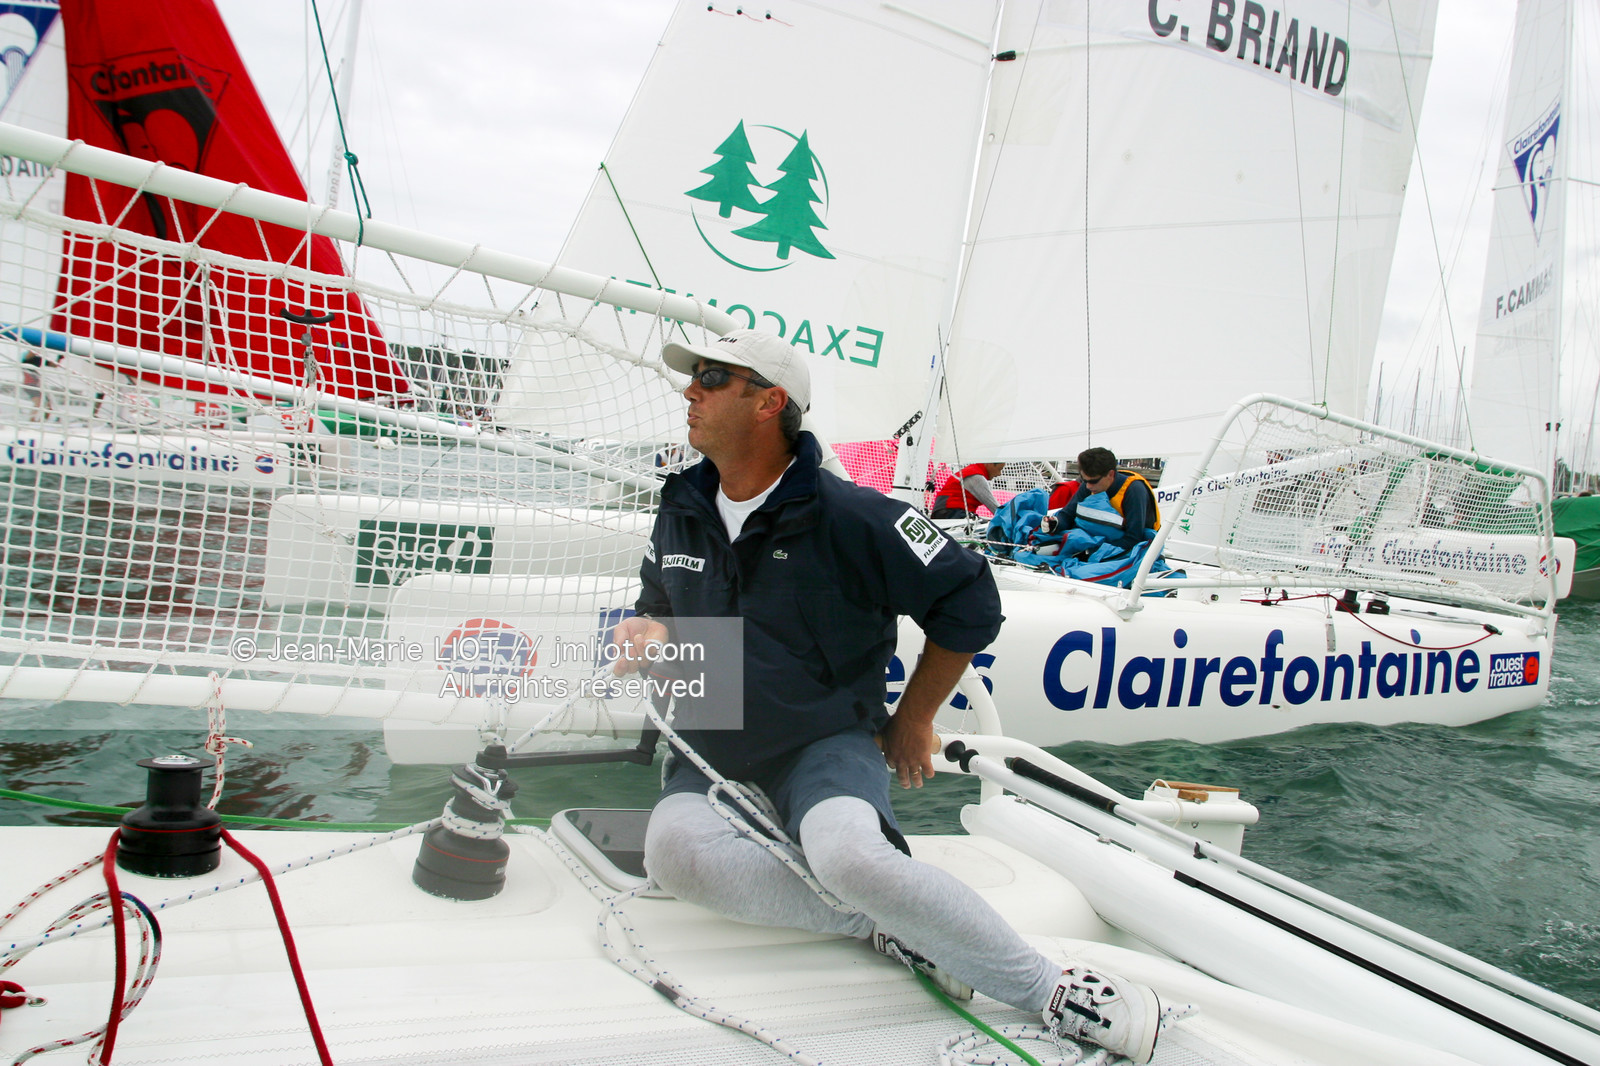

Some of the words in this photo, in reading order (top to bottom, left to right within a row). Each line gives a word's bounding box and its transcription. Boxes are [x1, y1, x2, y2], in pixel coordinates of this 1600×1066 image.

[1206, 0, 1350, 97] BRIAND
[1043, 626, 1481, 712] Clairefontaine
[1490, 669, 1524, 687] france
[1494, 653, 1525, 673] ouest
